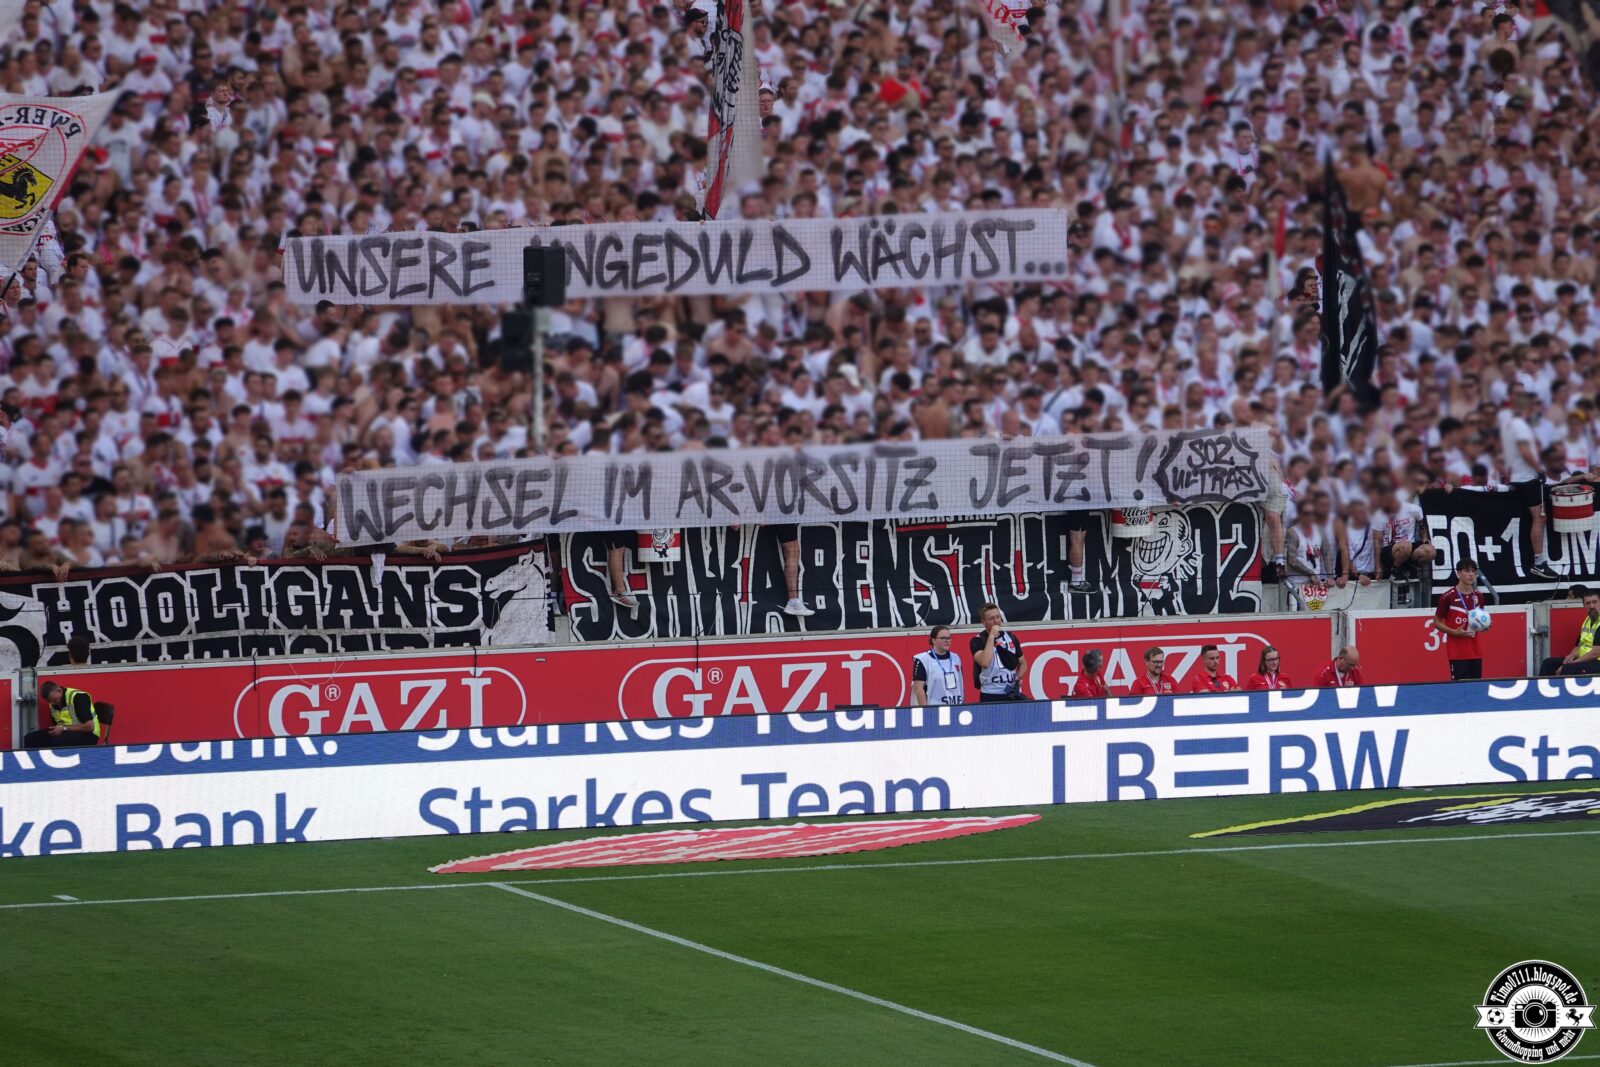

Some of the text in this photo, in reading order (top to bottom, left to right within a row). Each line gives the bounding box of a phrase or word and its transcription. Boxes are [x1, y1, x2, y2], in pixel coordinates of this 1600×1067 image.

[290, 217, 1067, 299] UNSERE NGEDULD WÄCHST...
[340, 461, 578, 542] WECHSEL
[604, 460, 652, 525] IM
[675, 445, 939, 519] AR-VORSITZ
[1172, 465, 1254, 496] ULTRAS
[1426, 515, 1526, 580] 50+1
[32, 564, 483, 648] HOOLIGANS
[1424, 619, 1447, 651] 3
[116, 792, 317, 851] Bank
[418, 772, 950, 834] Starkes Team
